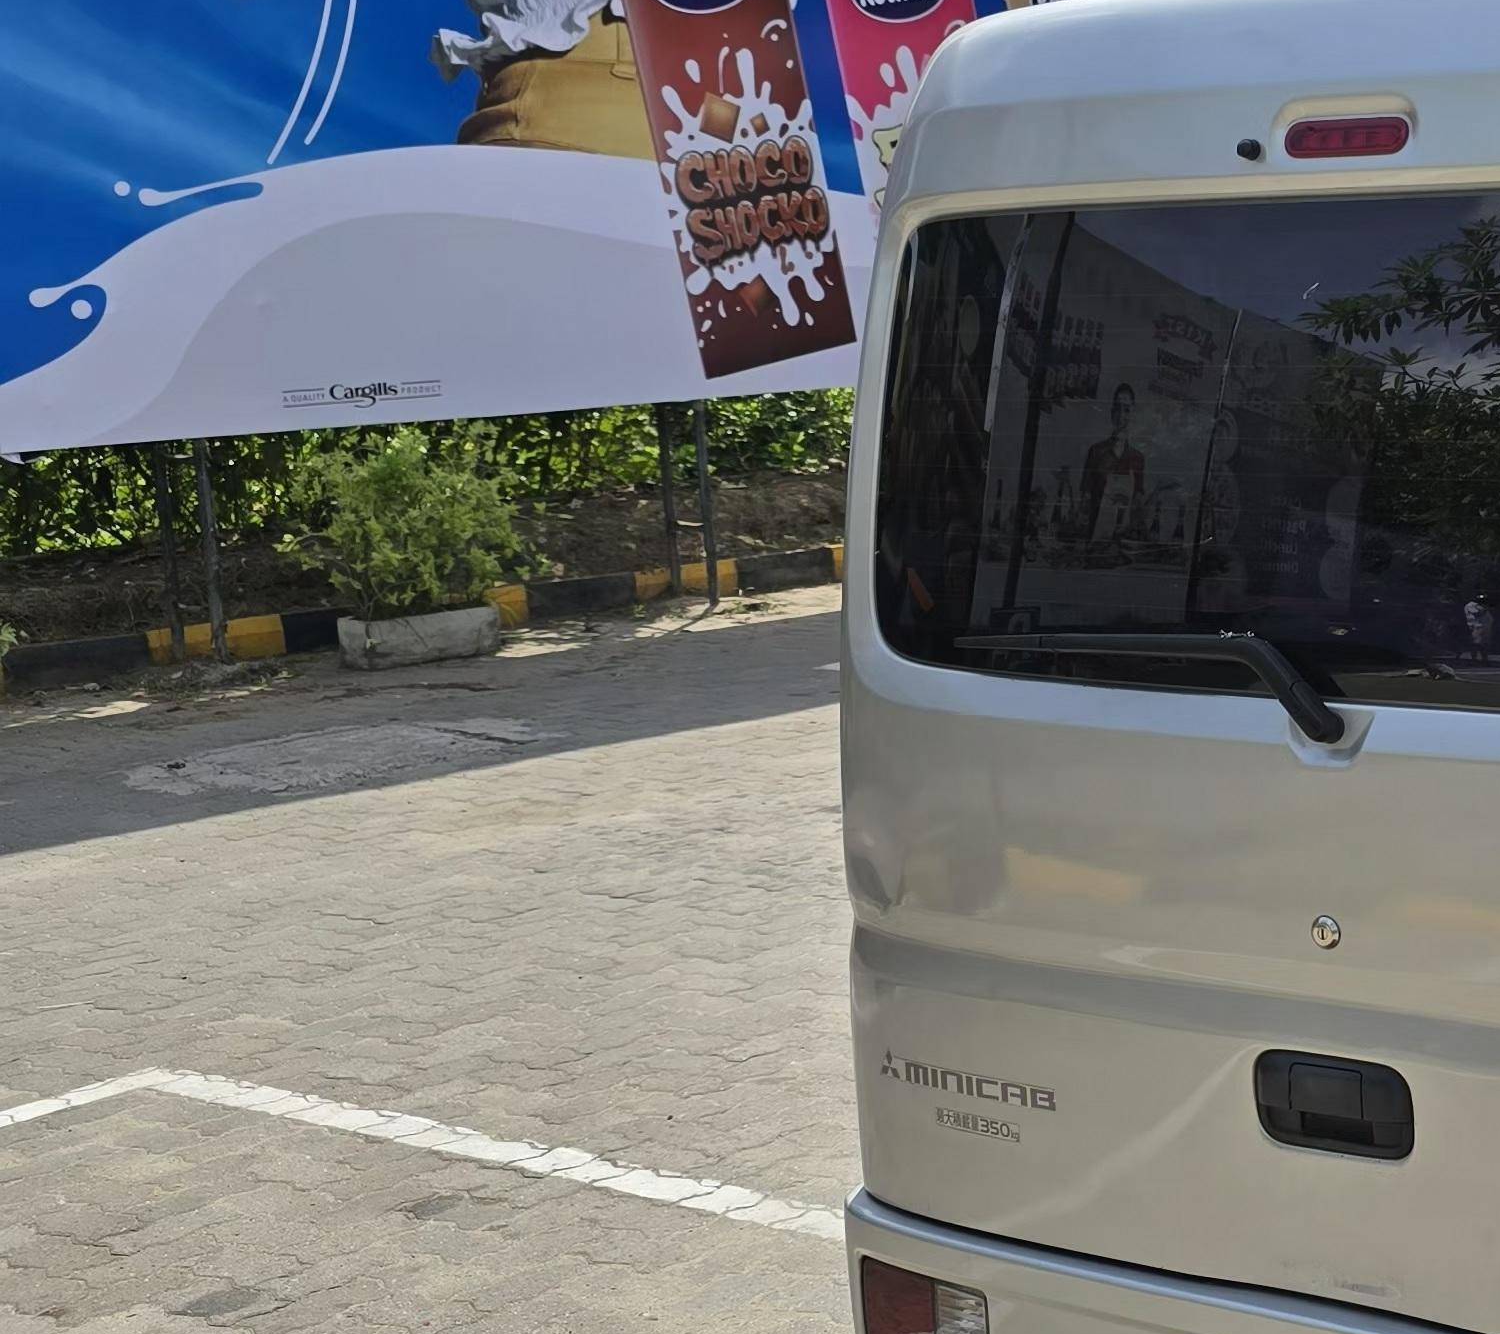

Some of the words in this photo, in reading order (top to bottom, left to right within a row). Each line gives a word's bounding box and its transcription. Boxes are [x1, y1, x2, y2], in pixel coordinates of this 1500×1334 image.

[674, 136, 814, 208] CHOCO
[685, 186, 830, 266] SHOCKO
[329, 382, 398, 408] Cargills
[905, 1062, 1056, 1112] MINICAB
